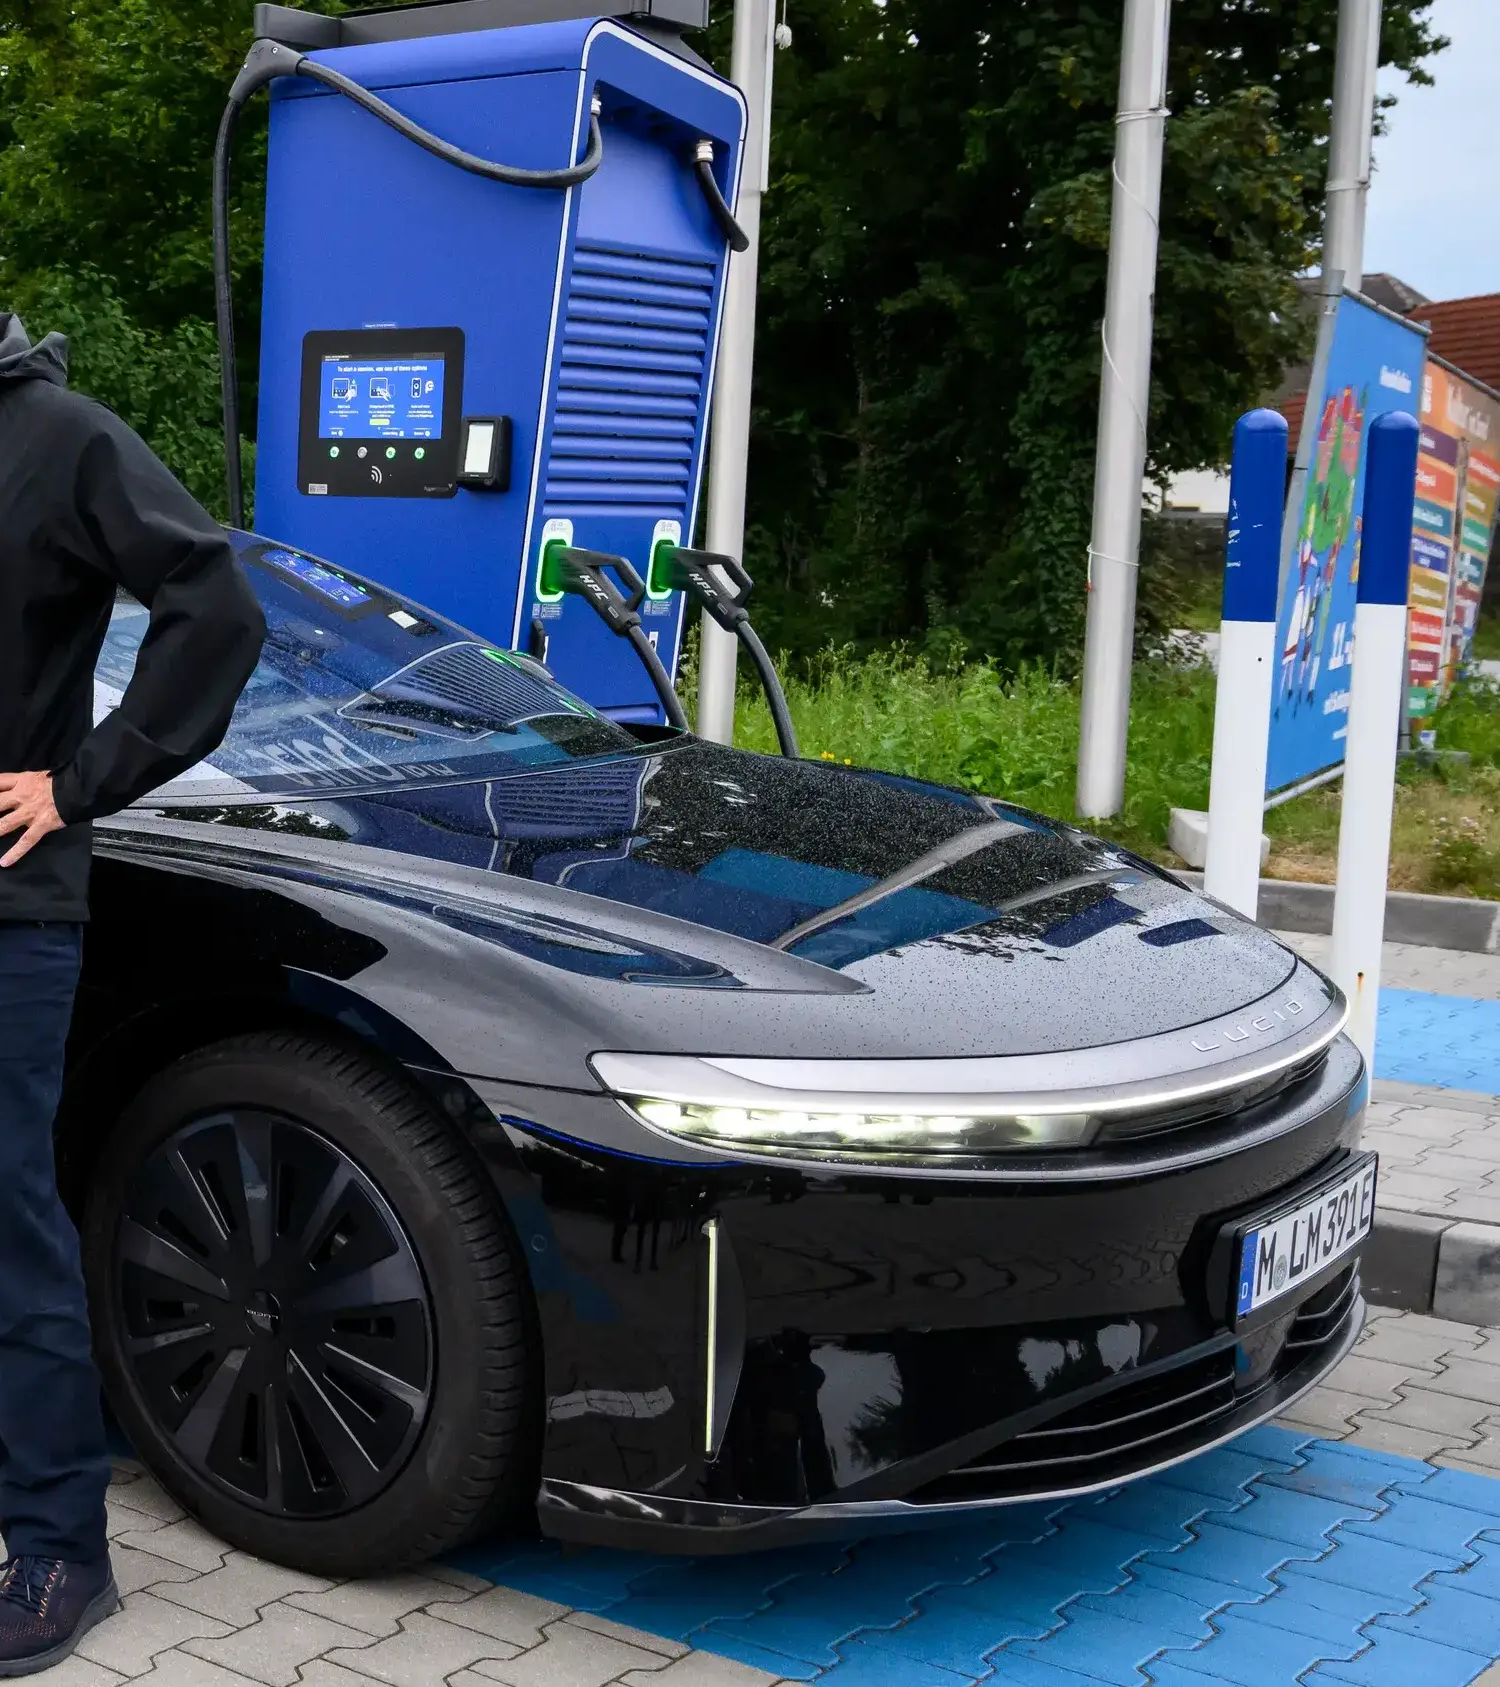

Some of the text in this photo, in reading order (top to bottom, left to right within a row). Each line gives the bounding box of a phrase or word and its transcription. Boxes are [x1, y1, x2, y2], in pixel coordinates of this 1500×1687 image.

[579, 574, 609, 601] HPC
[688, 573, 718, 598] HPC
[1190, 1000, 1304, 1052] LUCID
[1256, 1231, 1277, 1297] M
[1241, 1281, 1249, 1300] D
